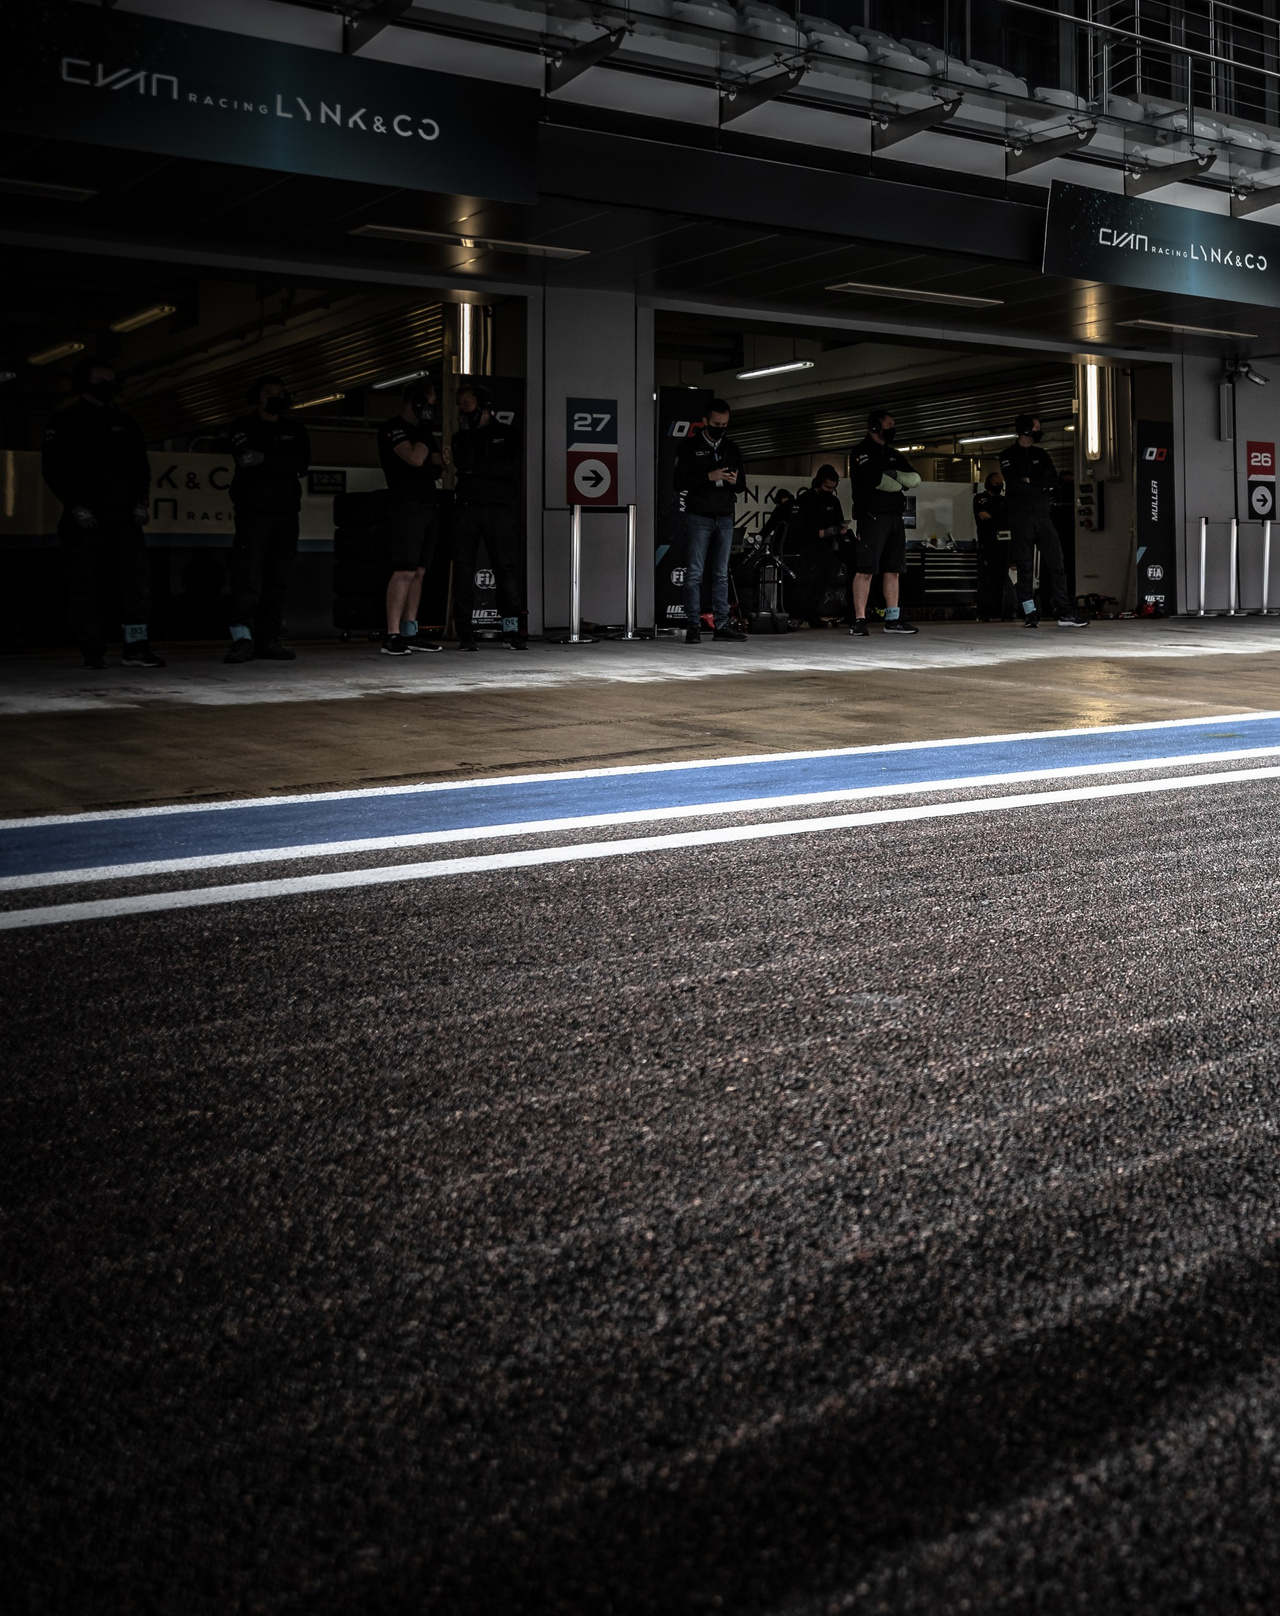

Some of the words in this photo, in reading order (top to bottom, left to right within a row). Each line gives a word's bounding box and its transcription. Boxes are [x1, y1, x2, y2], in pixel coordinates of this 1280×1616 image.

[188, 93, 268, 114] RACING
[1151, 246, 1188, 258] RACING
[573, 413, 611, 432] 27
[1250, 452, 1271, 466] 26
[1151, 480, 1159, 521] MULLER
[187, 511, 232, 521] RACI
